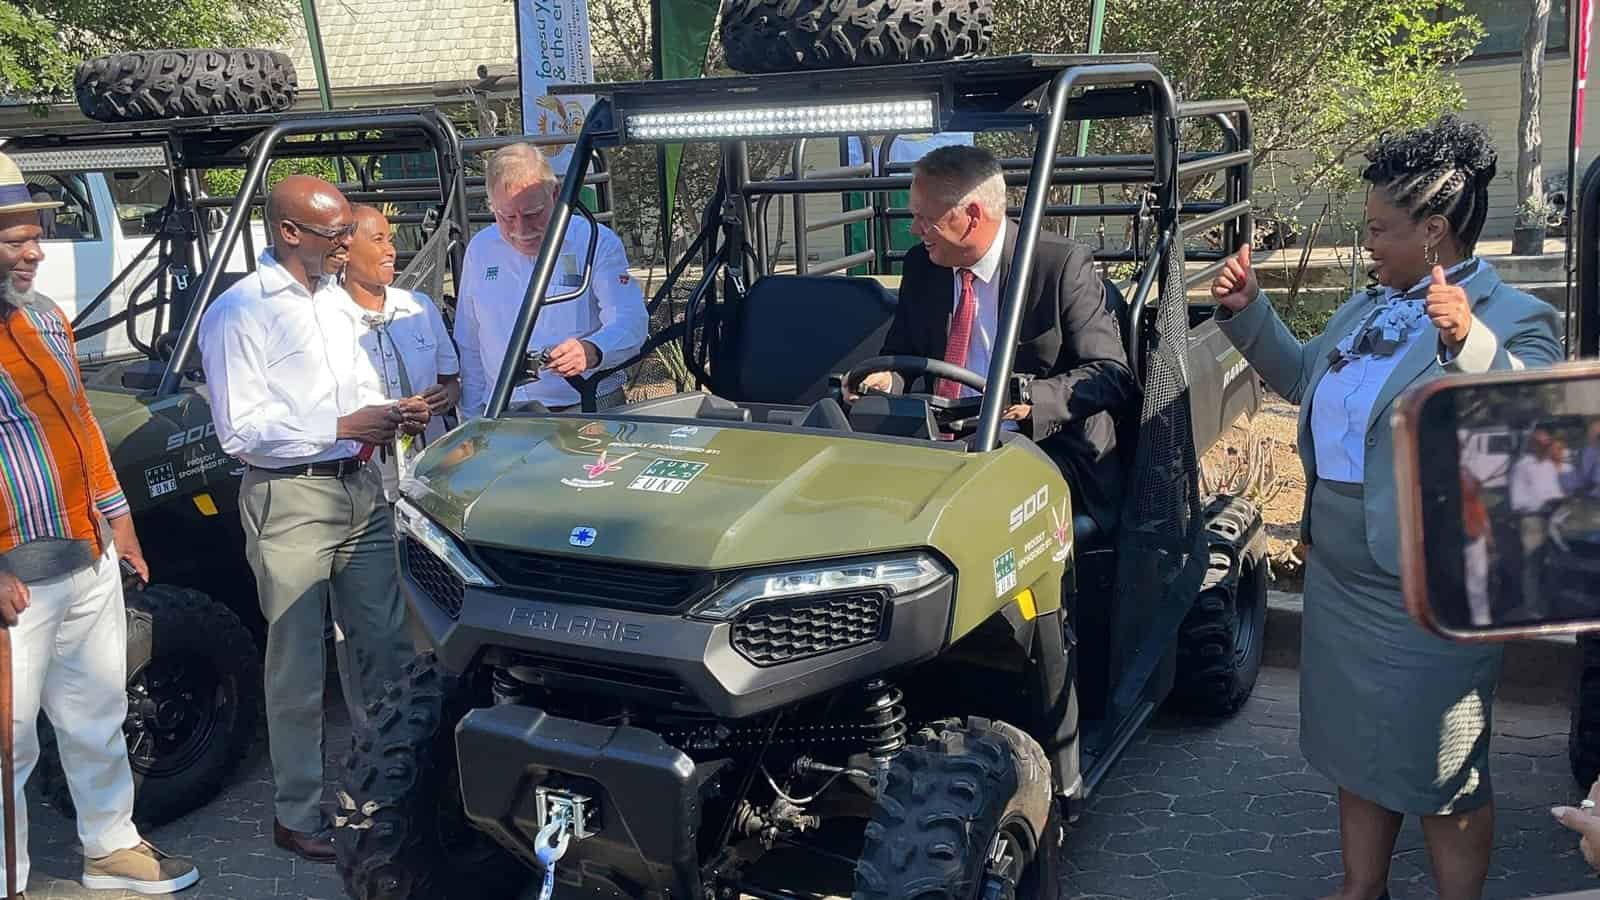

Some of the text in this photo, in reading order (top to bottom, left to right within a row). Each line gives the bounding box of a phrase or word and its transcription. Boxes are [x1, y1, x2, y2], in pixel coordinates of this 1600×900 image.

[550, 27, 564, 58] the
[552, 65, 566, 80] &
[629, 479, 687, 493] FUND
[1009, 484, 1049, 534] 500
[508, 607, 647, 641] POLARIS
